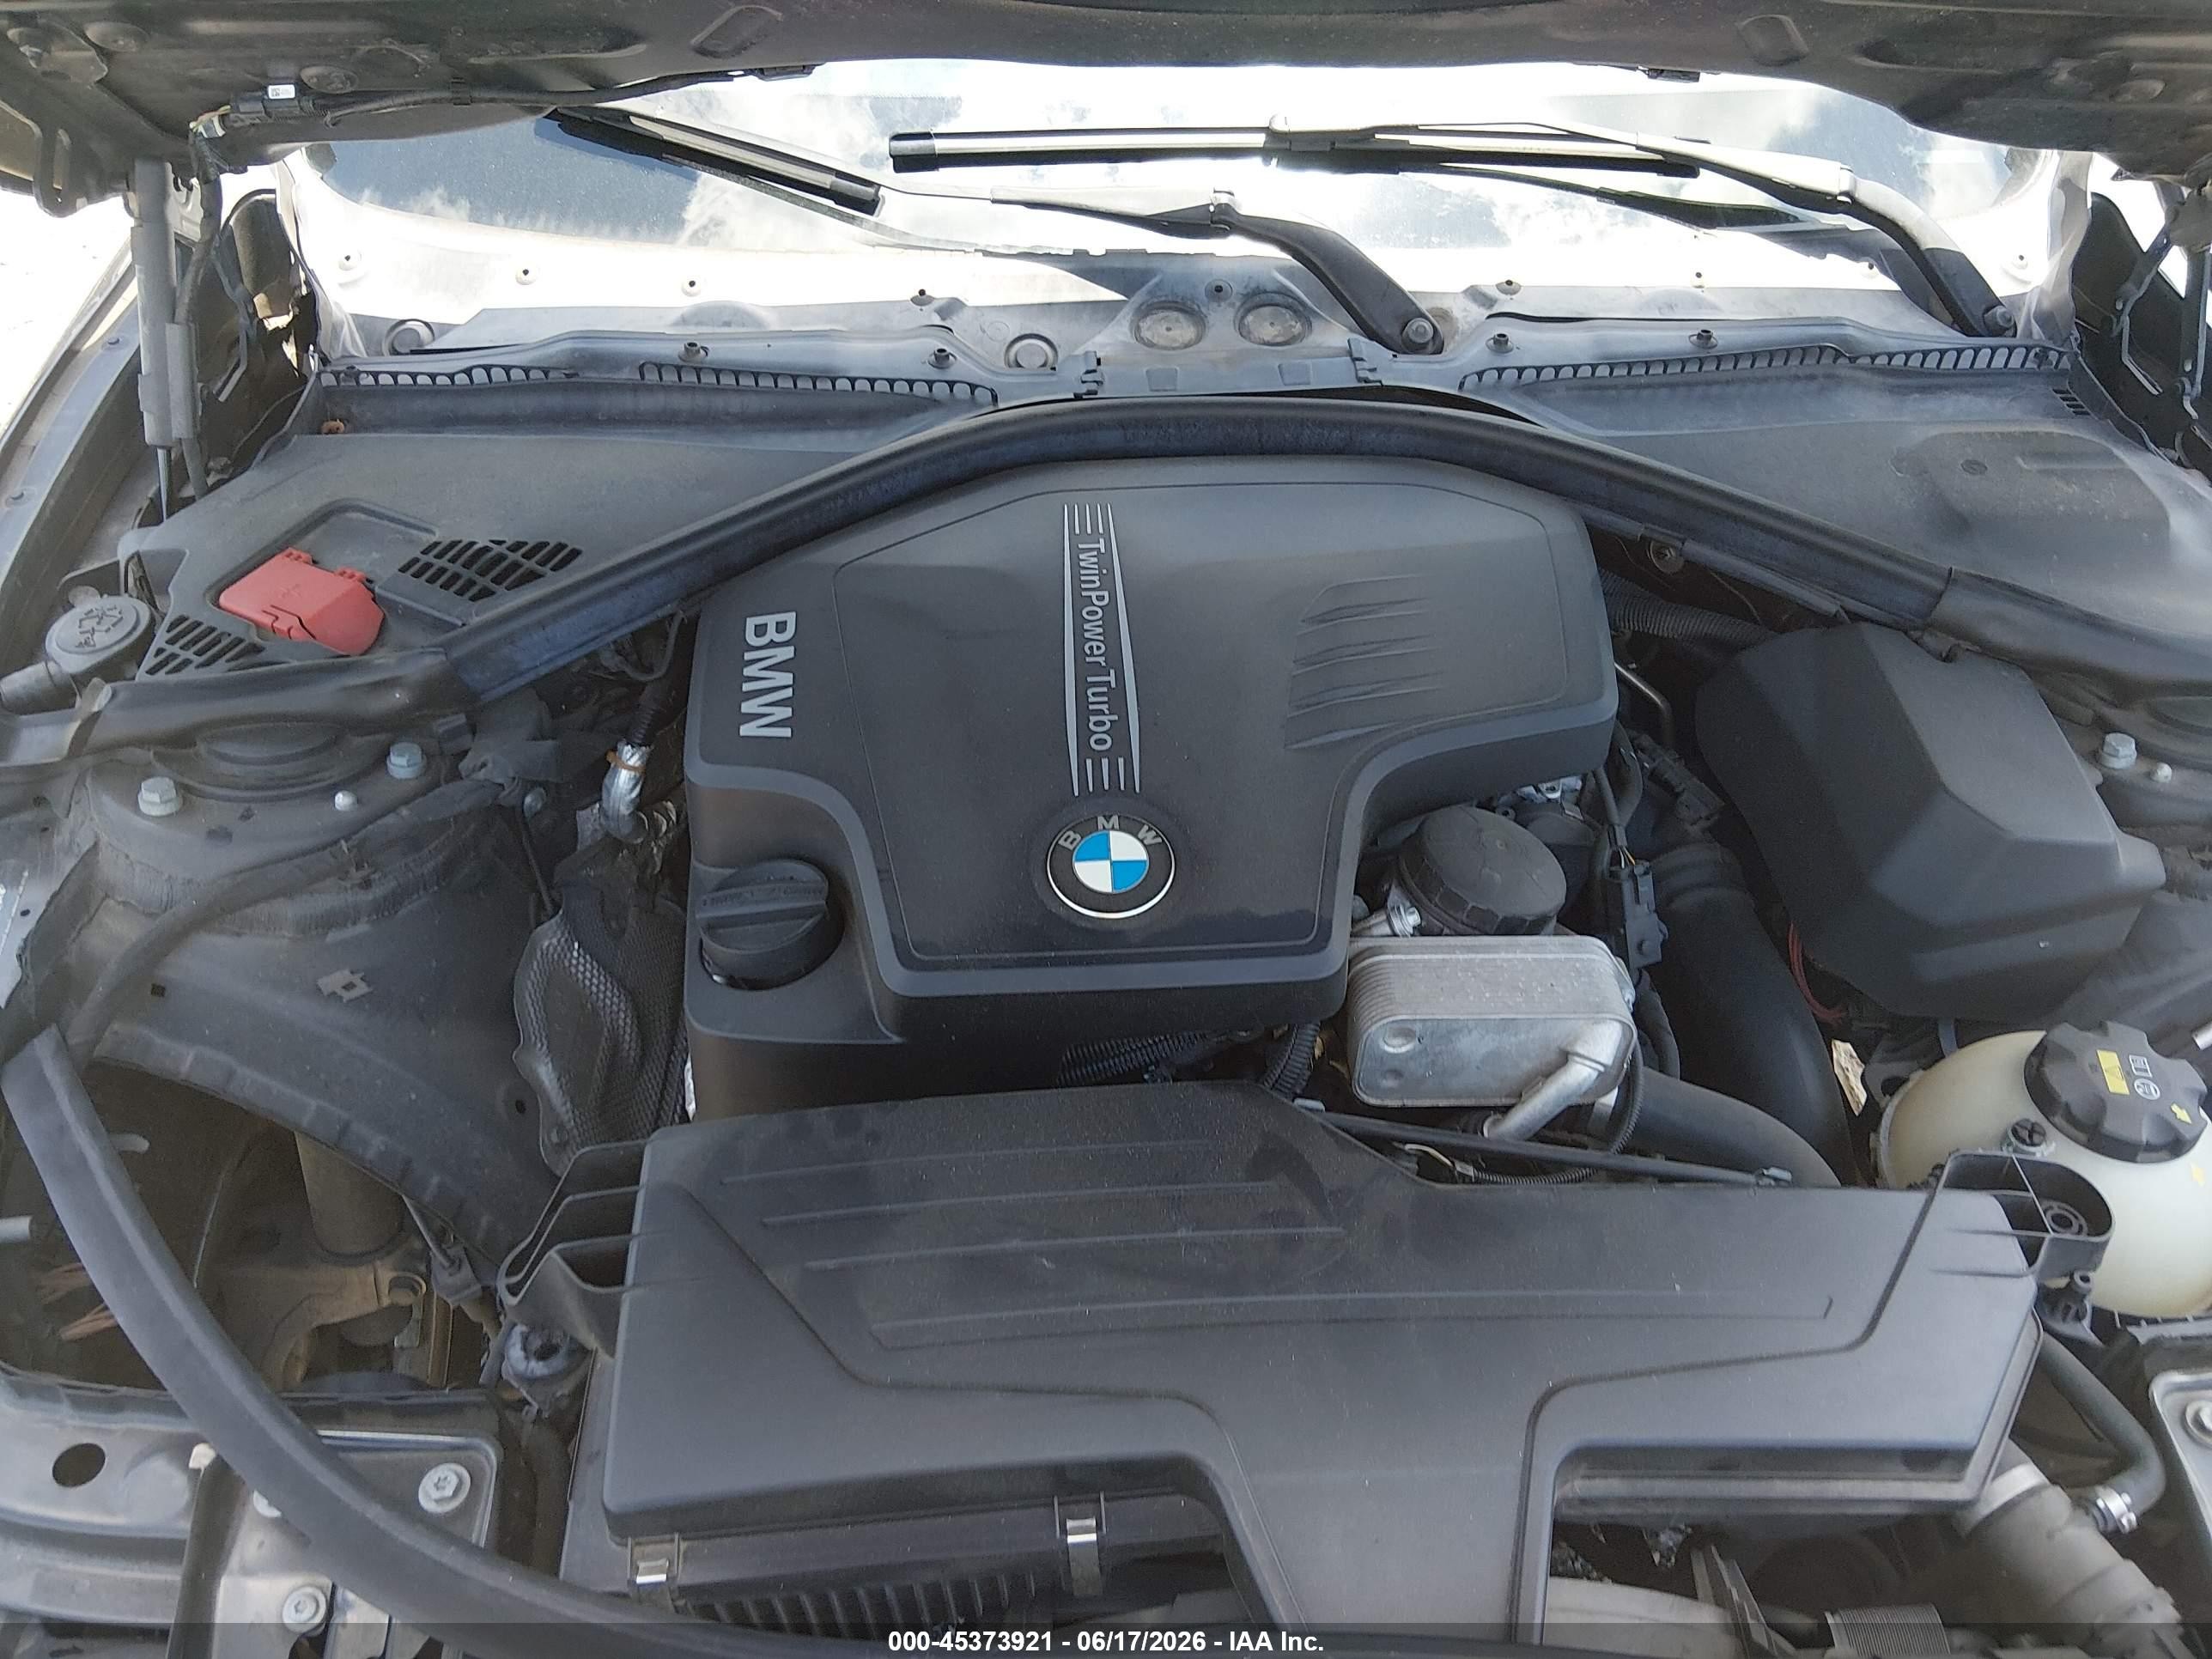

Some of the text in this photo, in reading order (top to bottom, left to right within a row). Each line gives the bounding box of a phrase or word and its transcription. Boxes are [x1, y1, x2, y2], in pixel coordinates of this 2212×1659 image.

[739, 611, 797, 738] BMW
[1078, 538, 1119, 751] TwinPower Turbo
[1058, 814, 1163, 851] BMW
